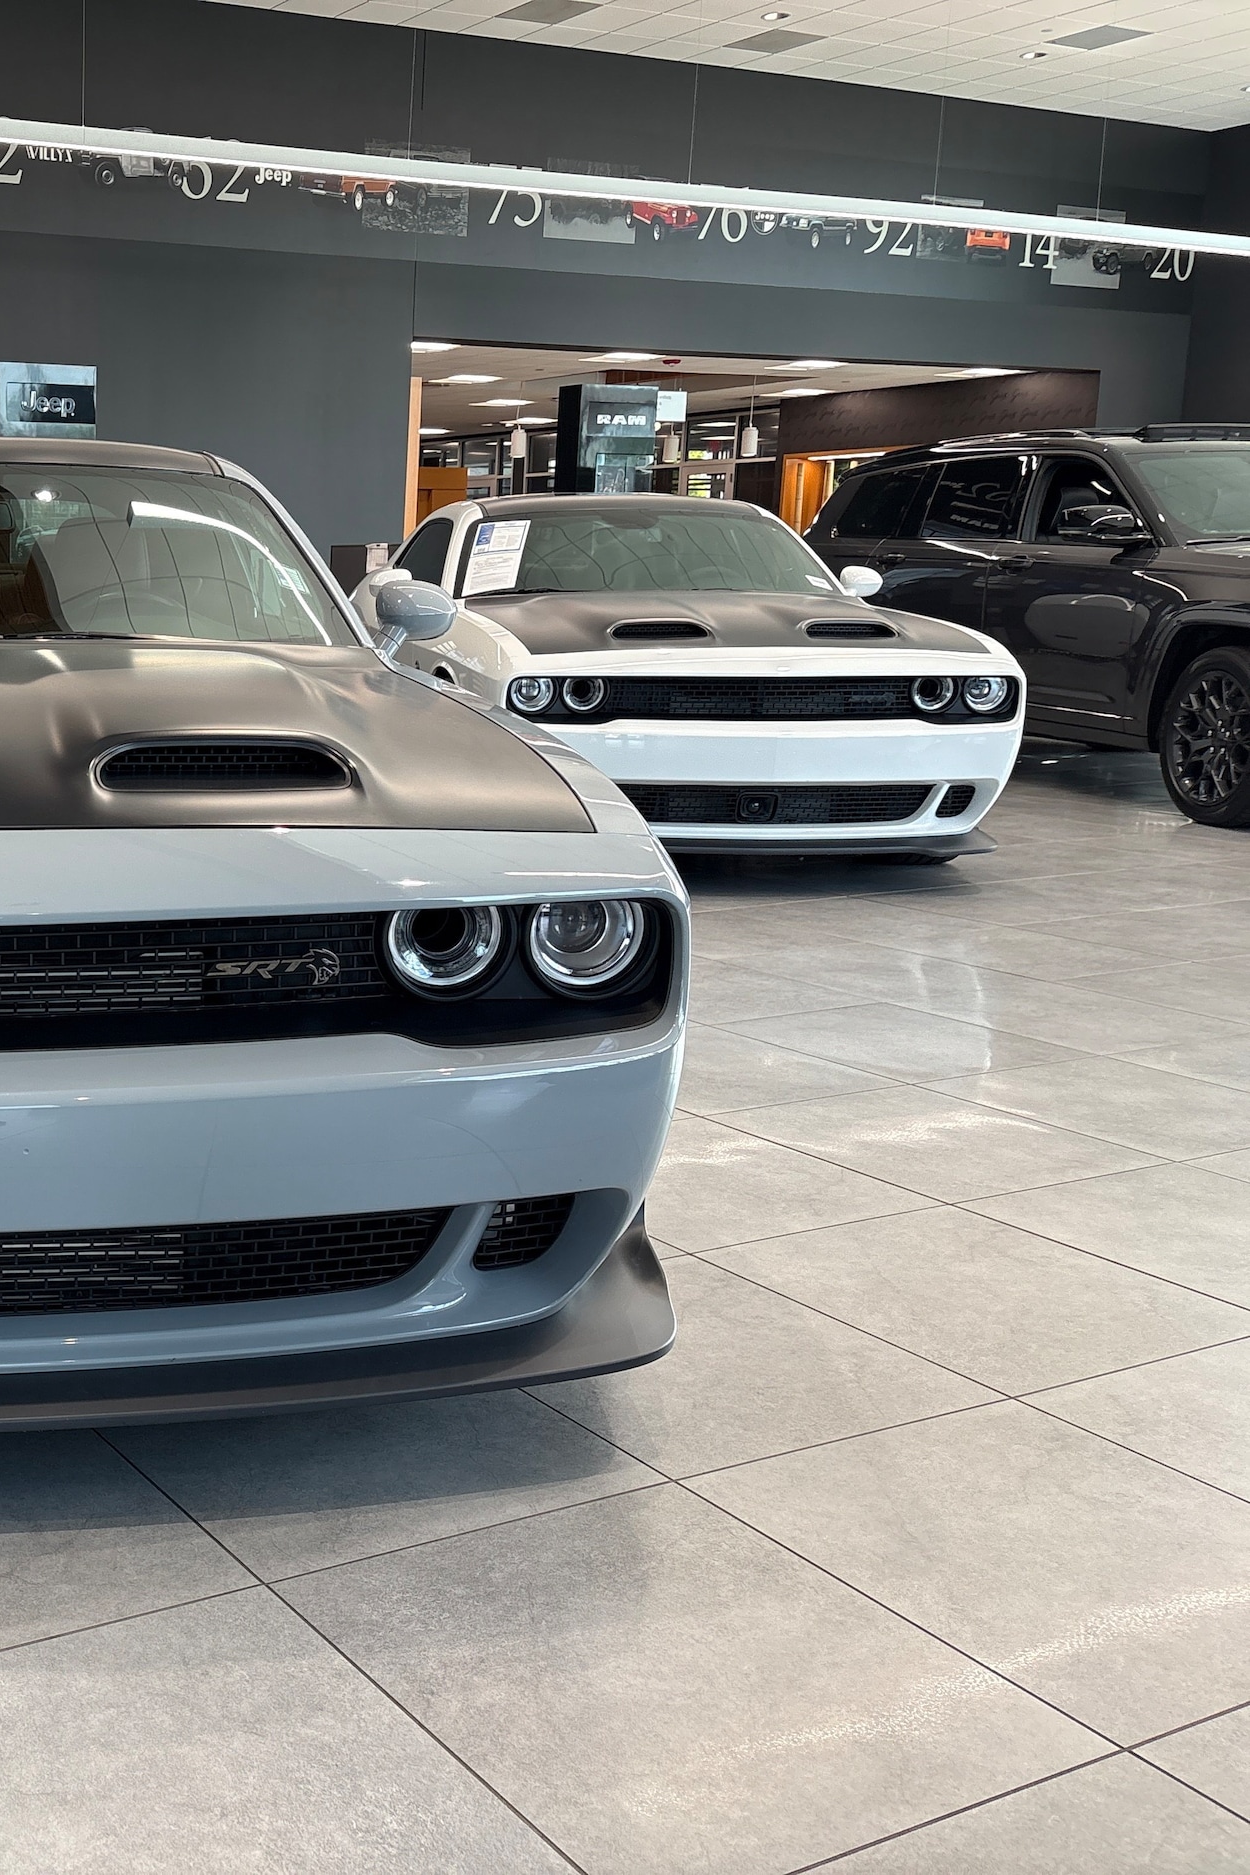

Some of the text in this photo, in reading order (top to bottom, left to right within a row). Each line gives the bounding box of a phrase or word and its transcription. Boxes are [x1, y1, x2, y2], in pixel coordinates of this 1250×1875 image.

[25, 145, 73, 162] WILLYS
[254, 167, 292, 187] Jeep
[863, 219, 914, 256] 92
[1018, 234, 1060, 270] 14
[1150, 248, 1196, 282] 20
[21, 390, 75, 418] Jeep
[596, 414, 647, 426] RAM
[206, 958, 316, 979] SRT
